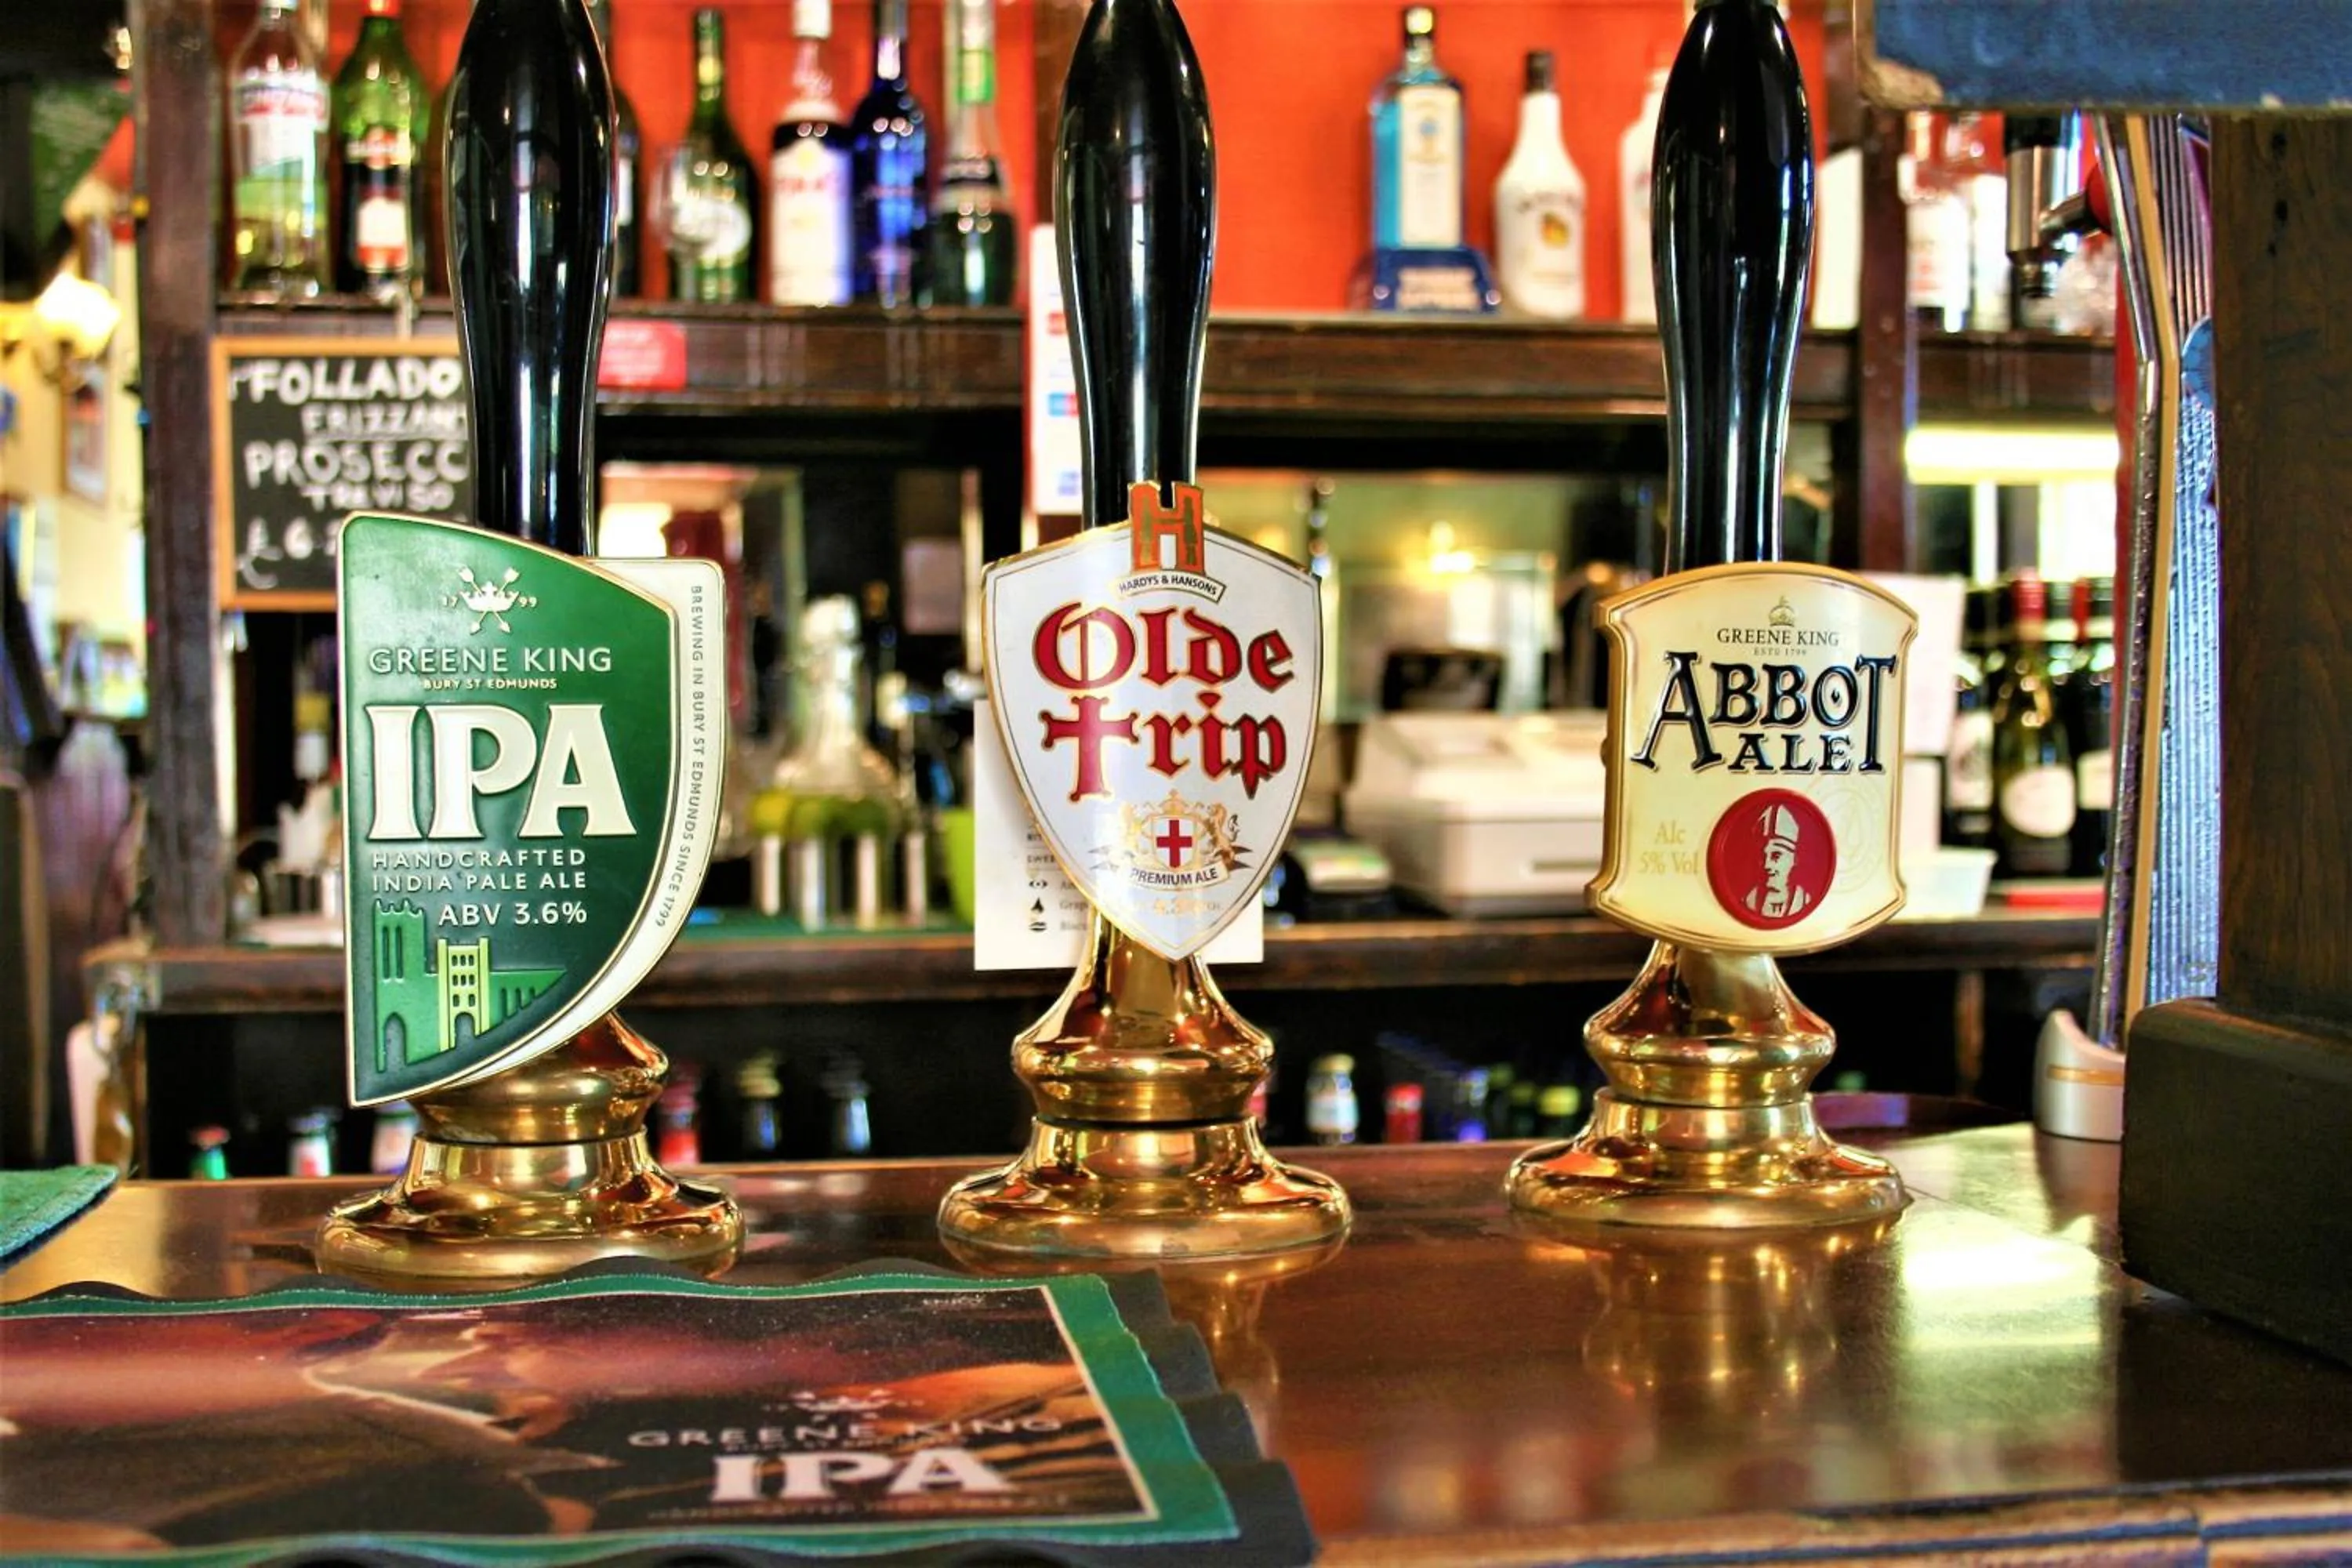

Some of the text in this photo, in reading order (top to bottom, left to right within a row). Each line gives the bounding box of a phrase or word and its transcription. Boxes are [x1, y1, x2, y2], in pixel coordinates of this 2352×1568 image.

[244, 438, 469, 489] PROSECC
[1118, 574, 1218, 596] HARDYS & HANSONS
[1032, 601, 1294, 692] Olde
[1716, 628, 1840, 646] GREENE KING
[368, 647, 612, 674] GREENE KING
[423, 677, 558, 690] BURY ST EDMUNDS
[1630, 650, 1896, 775] ABBOT
[655, 585, 706, 927] BREWING IN BURY ST EDMUNDS SINCE 1799
[1727, 732, 1852, 774] ALE
[364, 703, 638, 840] IPA
[1653, 818, 1686, 844] Alc
[372, 849, 586, 870] HANDCRAFTED
[372, 871, 586, 892] INDIA PALE ALE
[1131, 867, 1218, 885] PREMIUM ALE
[438, 902, 588, 927] ABV 3.6%
[628, 1422, 877, 1448] GREENE
[908, 1416, 1063, 1437] KING
[710, 1447, 1016, 1501] IPA
